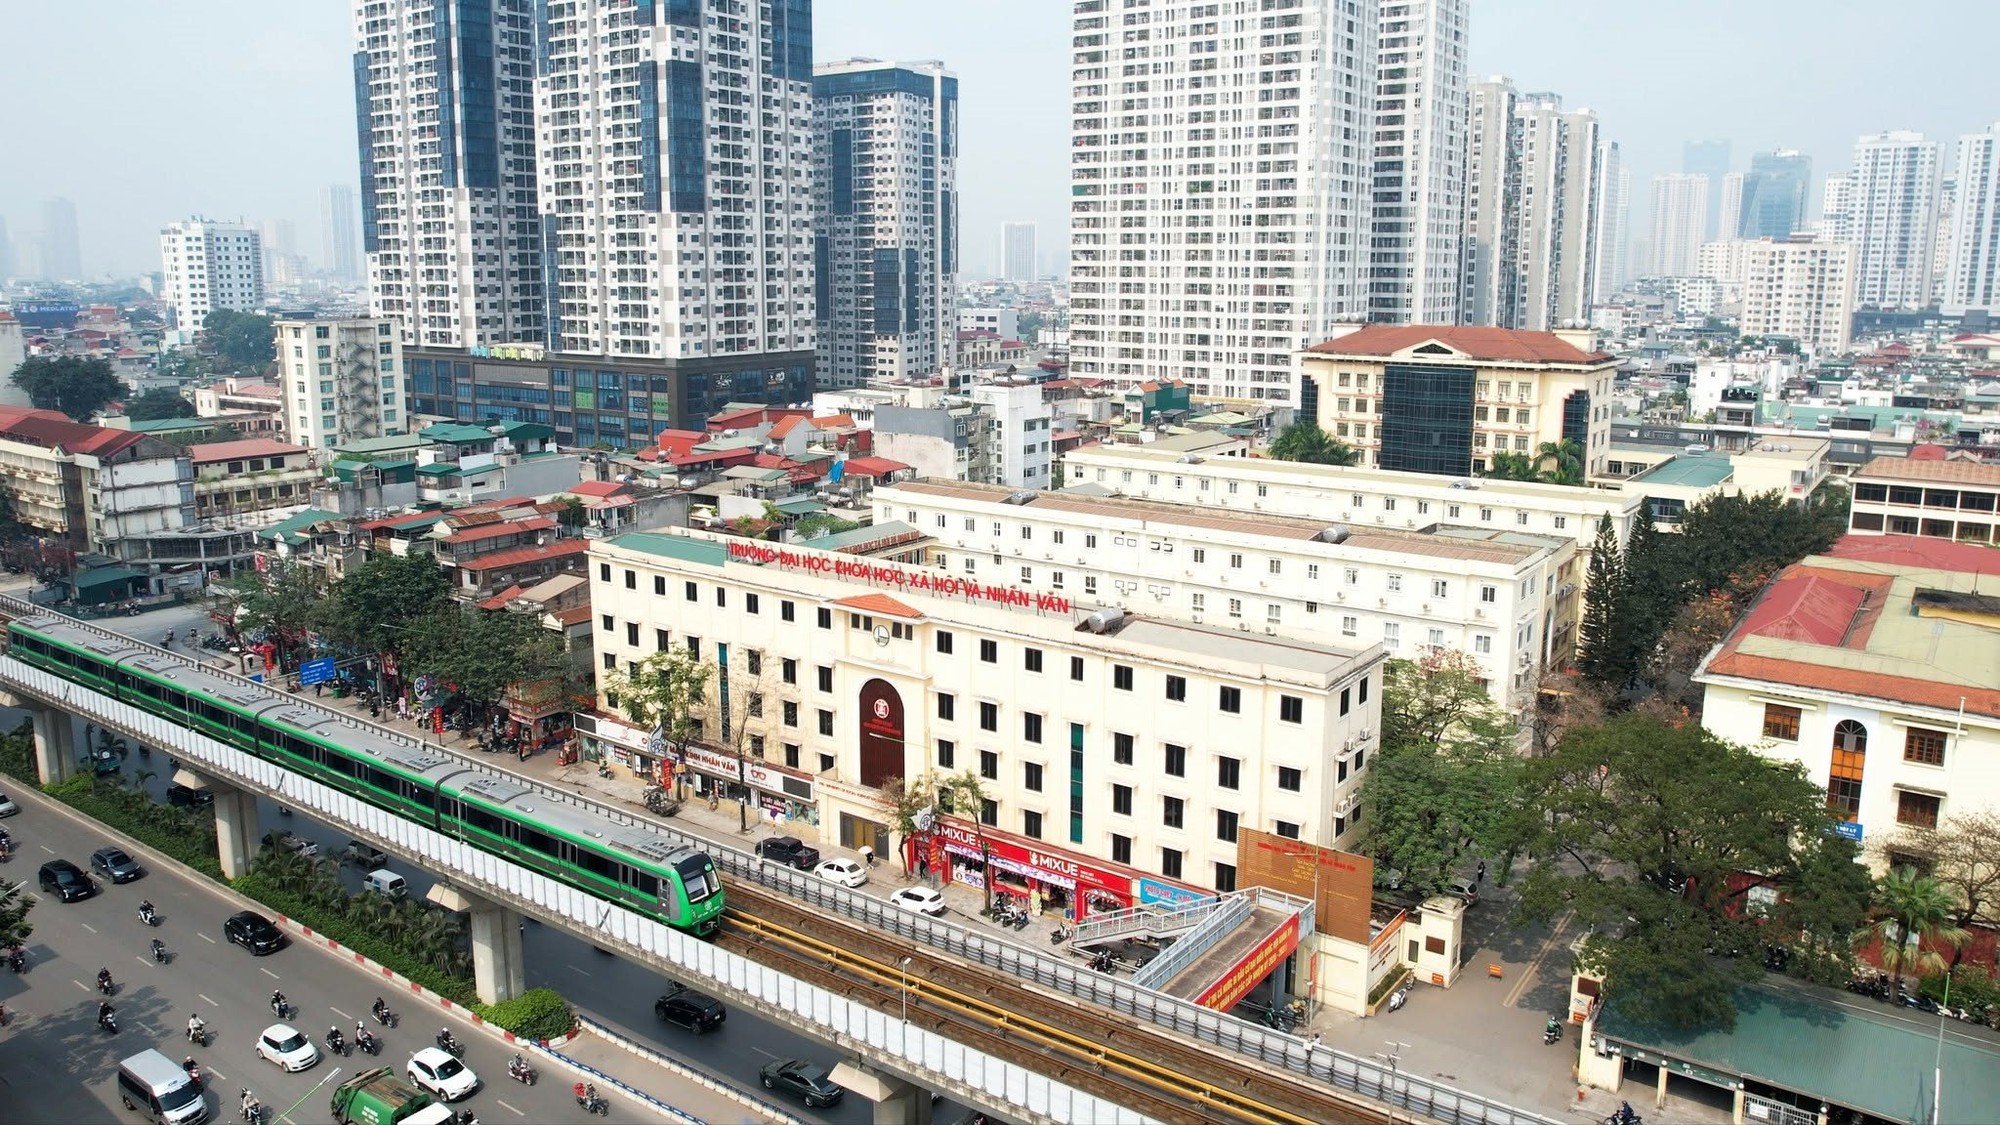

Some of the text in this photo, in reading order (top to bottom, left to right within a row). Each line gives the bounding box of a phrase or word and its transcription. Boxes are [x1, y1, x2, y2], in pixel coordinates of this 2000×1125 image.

[729, 541, 1068, 614] TRƯỜNG ĐẠI HỌC KHOA HỌC XÃ HỘI VÀ NHÂN VĂN
[941, 826, 976, 846] MIXUE
[1040, 855, 1078, 877] MIXUE
